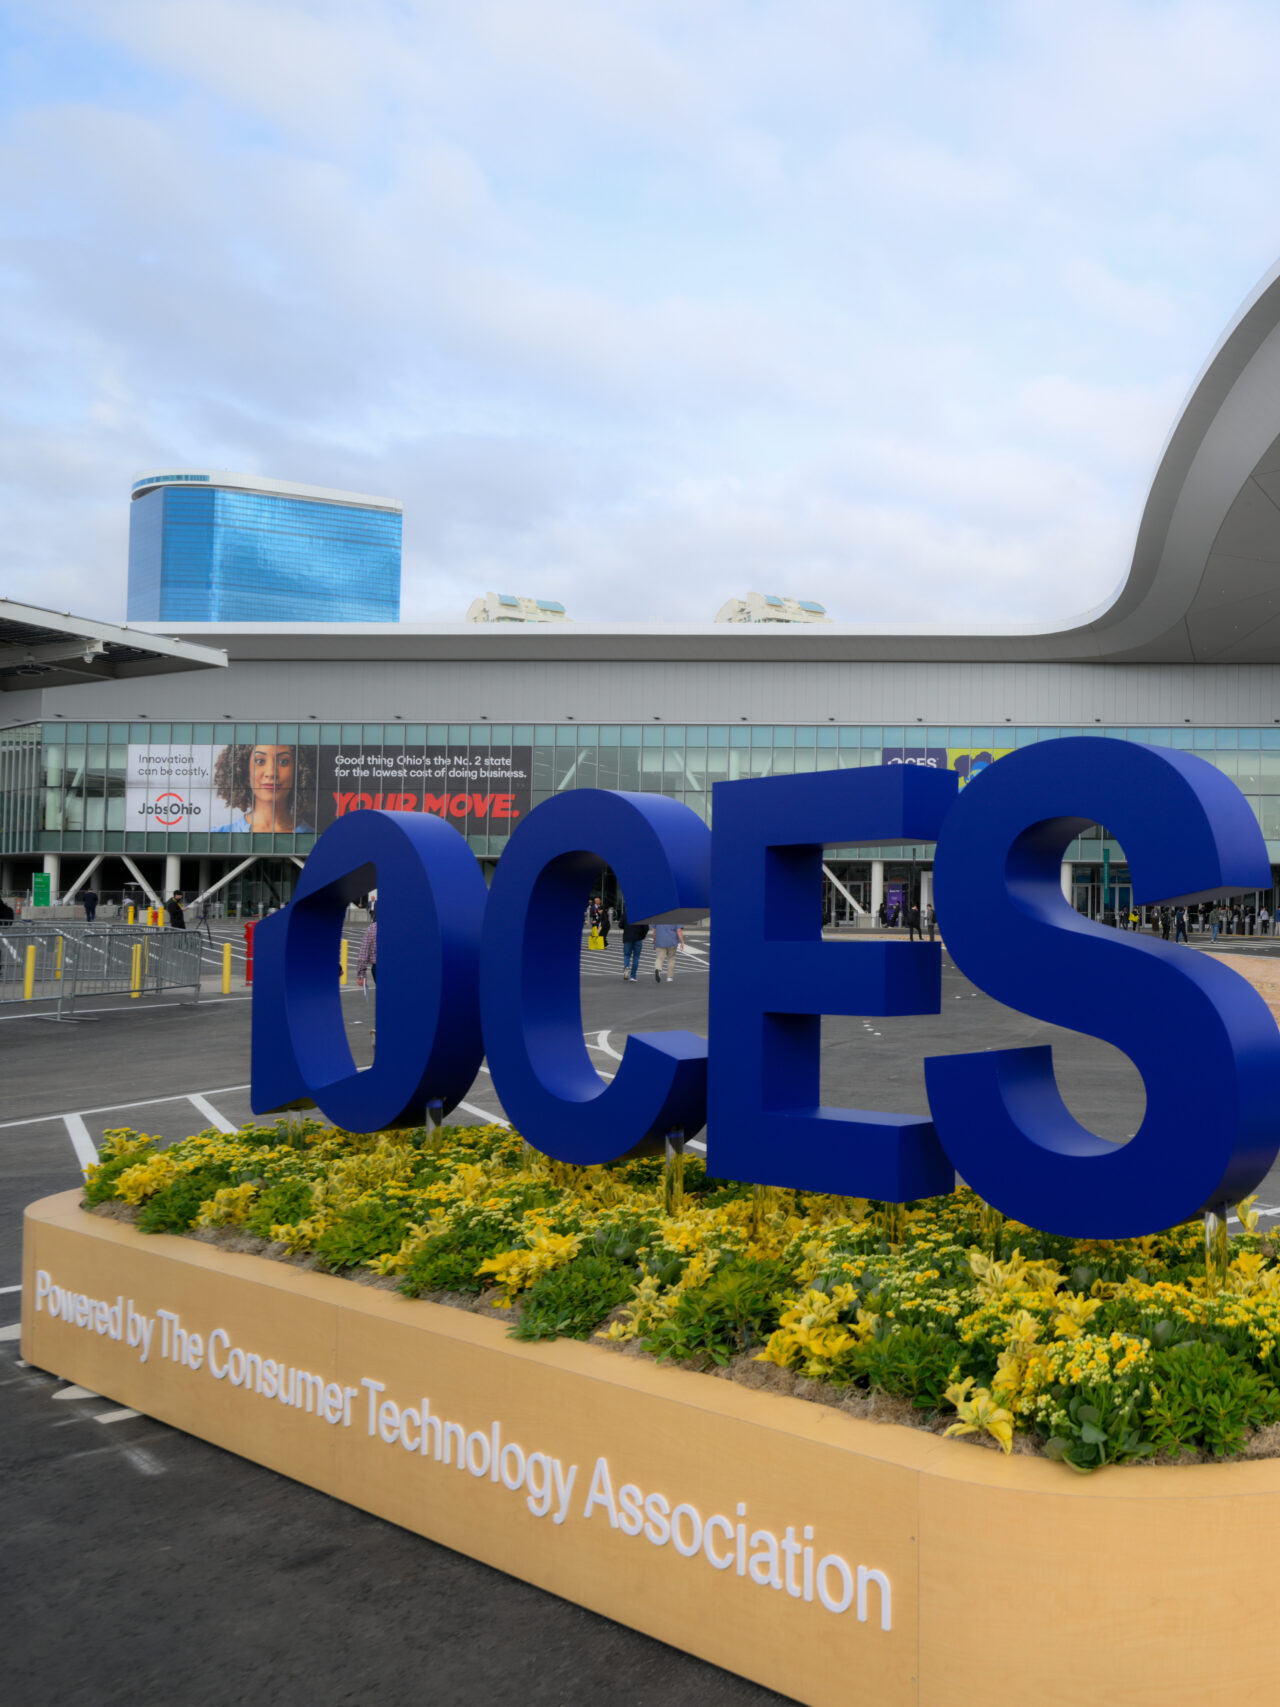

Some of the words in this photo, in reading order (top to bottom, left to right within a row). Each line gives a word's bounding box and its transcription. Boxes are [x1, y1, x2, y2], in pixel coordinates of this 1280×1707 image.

[139, 754, 194, 764] Innovation
[335, 755, 364, 765] Good
[367, 755, 394, 767] thing
[396, 755, 431, 766] Ohio's
[433, 756, 451, 766] the
[474, 756, 482, 766] 2
[484, 757, 511, 766] state
[138, 768, 157, 776] can
[160, 766, 172, 776] be
[175, 766, 209, 778] costly.
[335, 767, 350, 777] for
[352, 767, 370, 777] the
[372, 767, 407, 777] lowest
[409, 768, 432, 777] cost
[434, 768, 447, 777] of
[448, 768, 478, 780] doing
[480, 768, 527, 778] business.
[138, 803, 201, 815] JobsOhio
[422, 793, 520, 818] MOVE.
[36, 1270, 123, 1341] Powered
[127, 1299, 155, 1363] by
[157, 1308, 203, 1370] The
[208, 1328, 358, 1427] Consumer
[359, 1378, 578, 1526] Technology
[584, 1456, 892, 1631] Association
